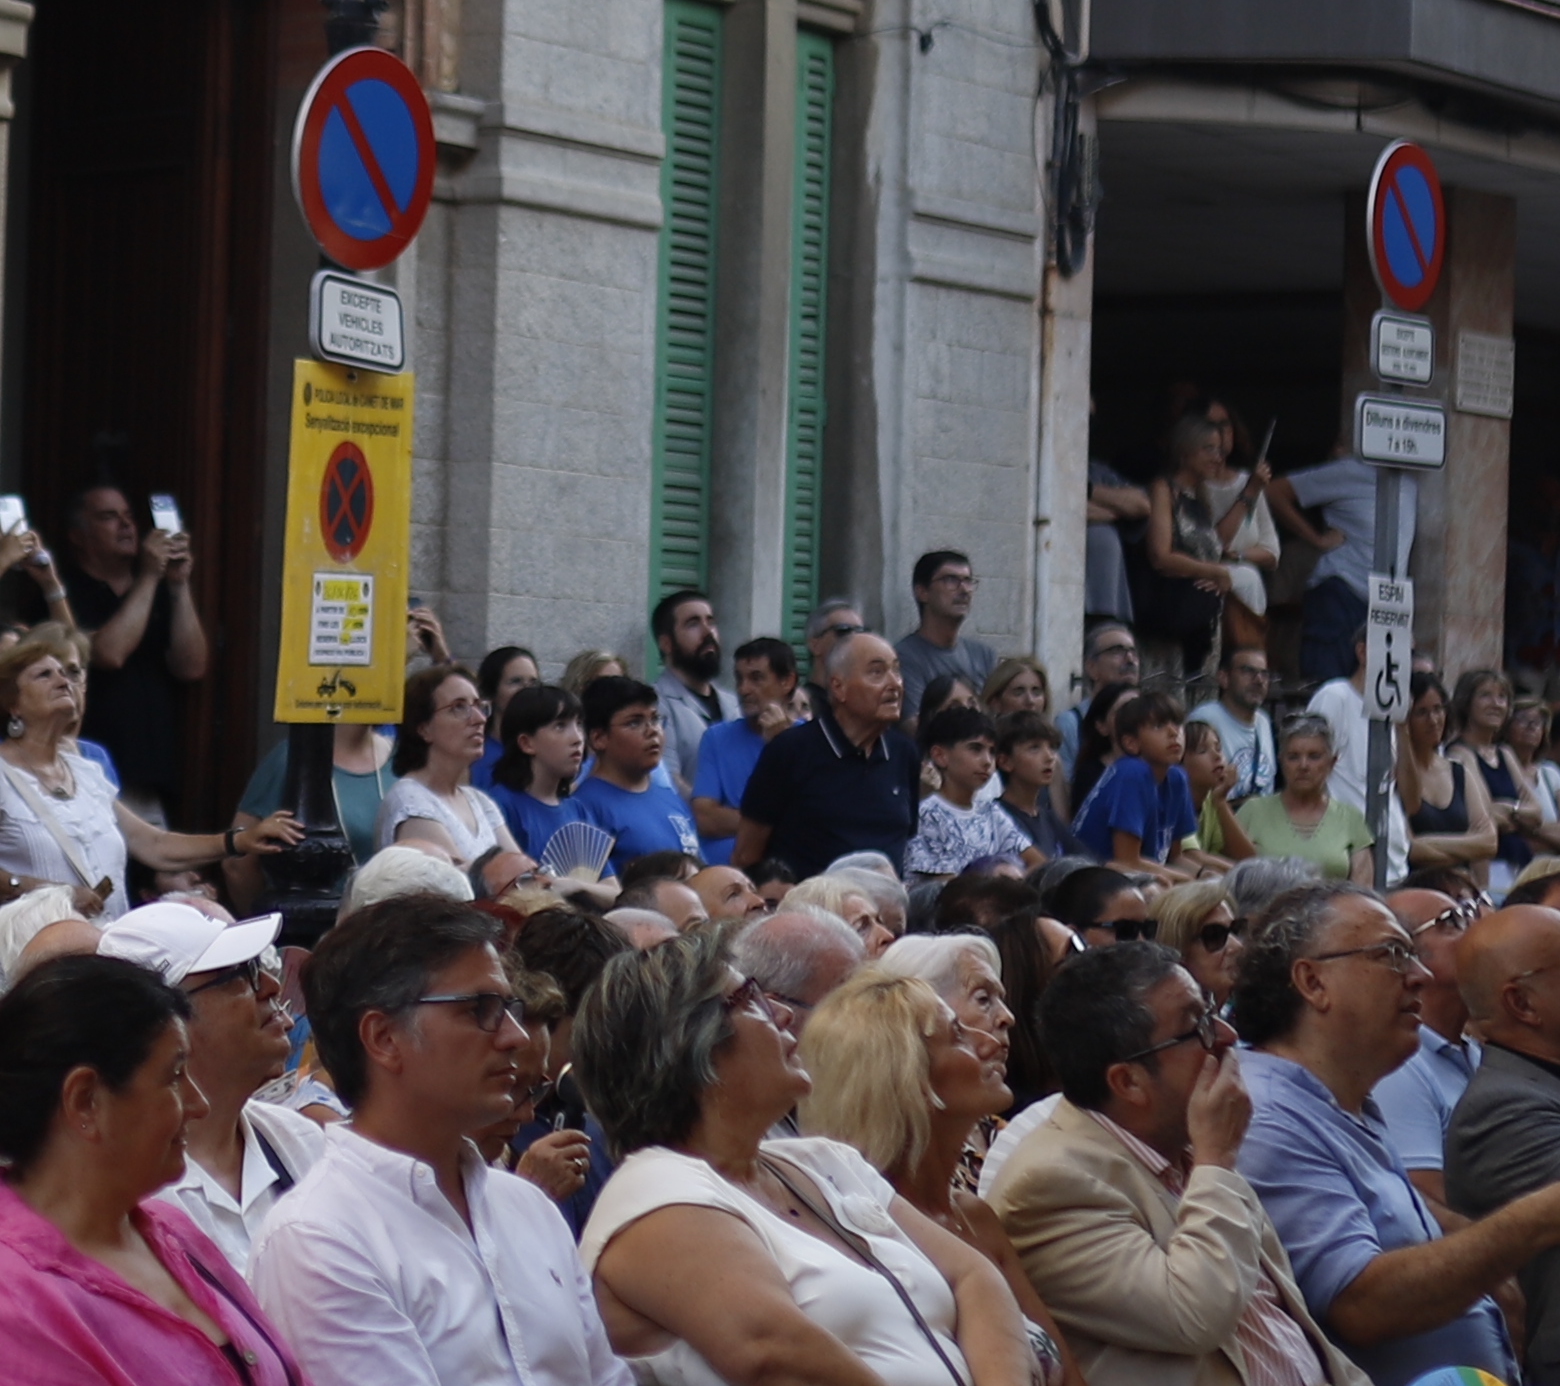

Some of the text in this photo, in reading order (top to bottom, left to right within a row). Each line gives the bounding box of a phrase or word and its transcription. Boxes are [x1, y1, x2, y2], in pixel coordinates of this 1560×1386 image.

[340, 289, 382, 315] EXCEPTE
[337, 312, 384, 337] VEHICLES
[329, 331, 395, 361] AUTORITZATS
[1366, 409, 1393, 429] Dilluns
[1402, 414, 1441, 436] divendres
[1370, 608, 1409, 628] RESERVAT
